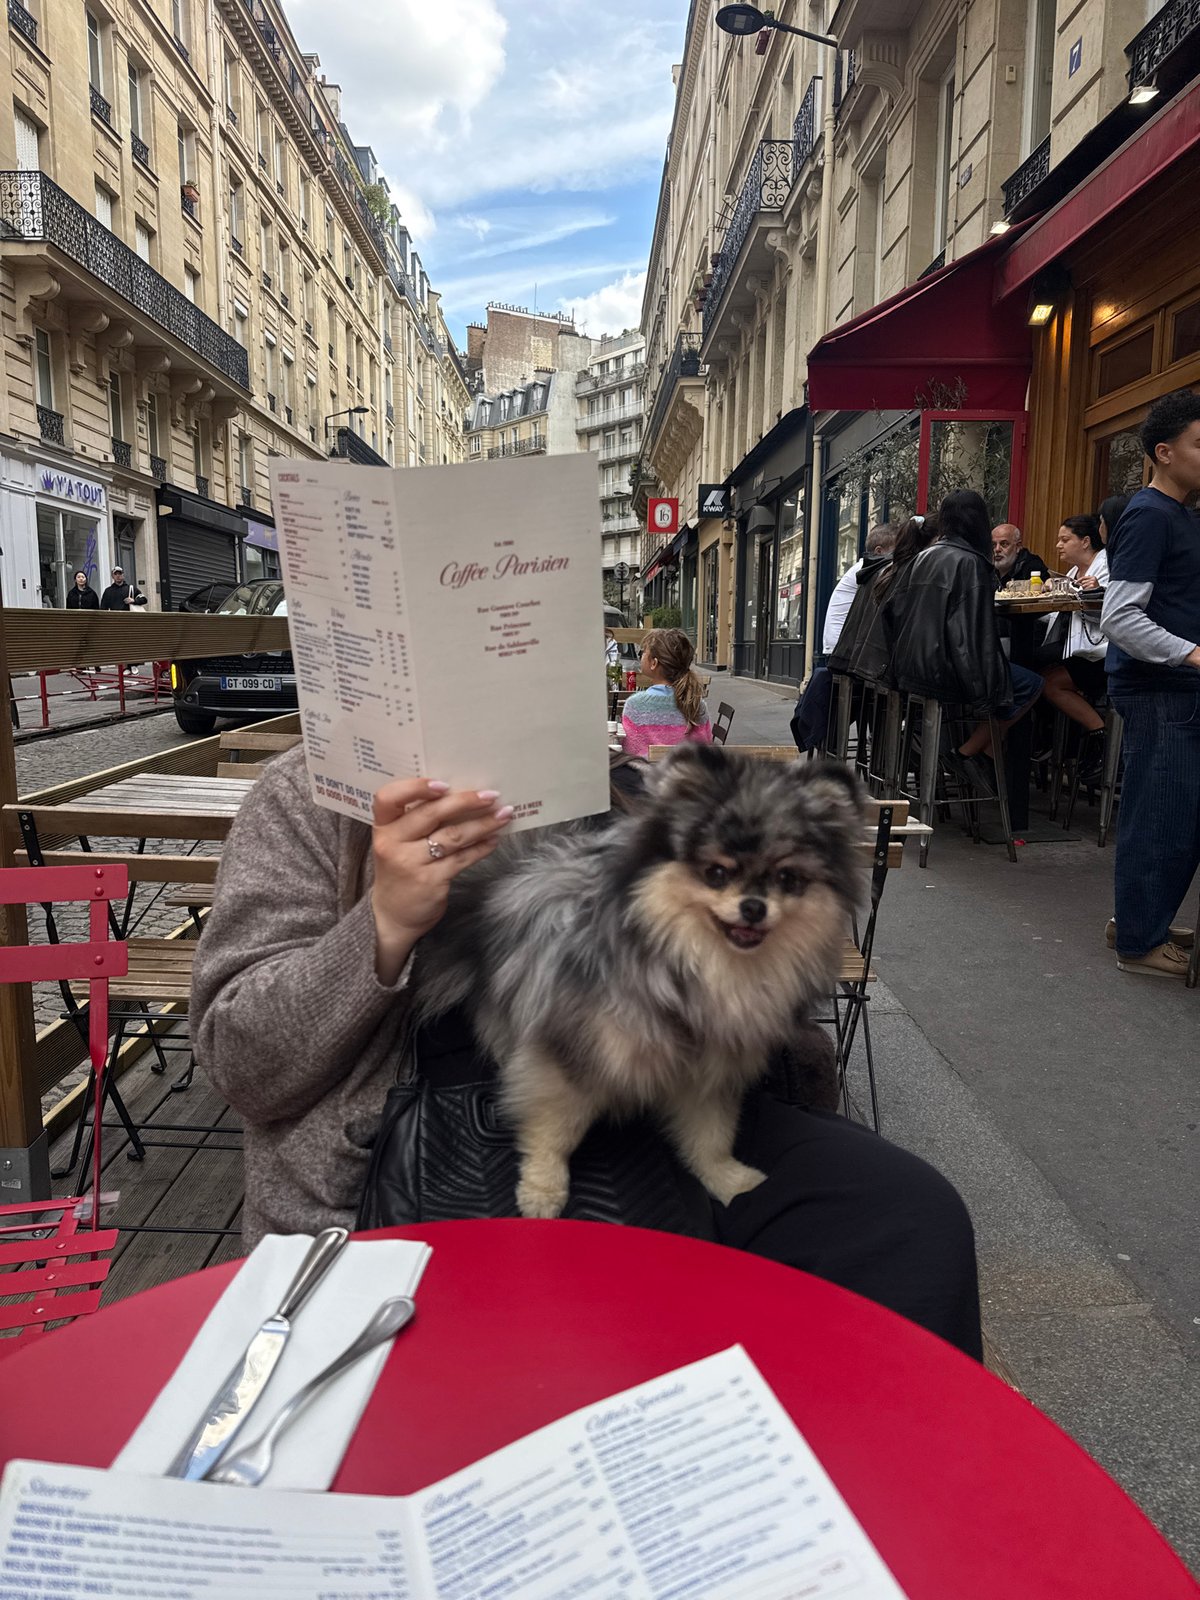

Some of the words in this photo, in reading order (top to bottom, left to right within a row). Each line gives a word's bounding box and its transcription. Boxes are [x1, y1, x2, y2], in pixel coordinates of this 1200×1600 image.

[1072, 43, 1080, 73] 7
[76, 481, 102, 503] TOUT
[440, 561, 489, 589] Coffee
[493, 553, 570, 580] Parisien
[227, 679, 274, 688] GT-099-CD
[314, 773, 325, 785] WE
[326, 777, 344, 791] DON'T
[345, 784, 355, 796] DO
[355, 788, 371, 802] FAST
[316, 785, 325, 796] DO
[326, 788, 342, 801] GOOD
[528, 801, 542, 809] WEEK
